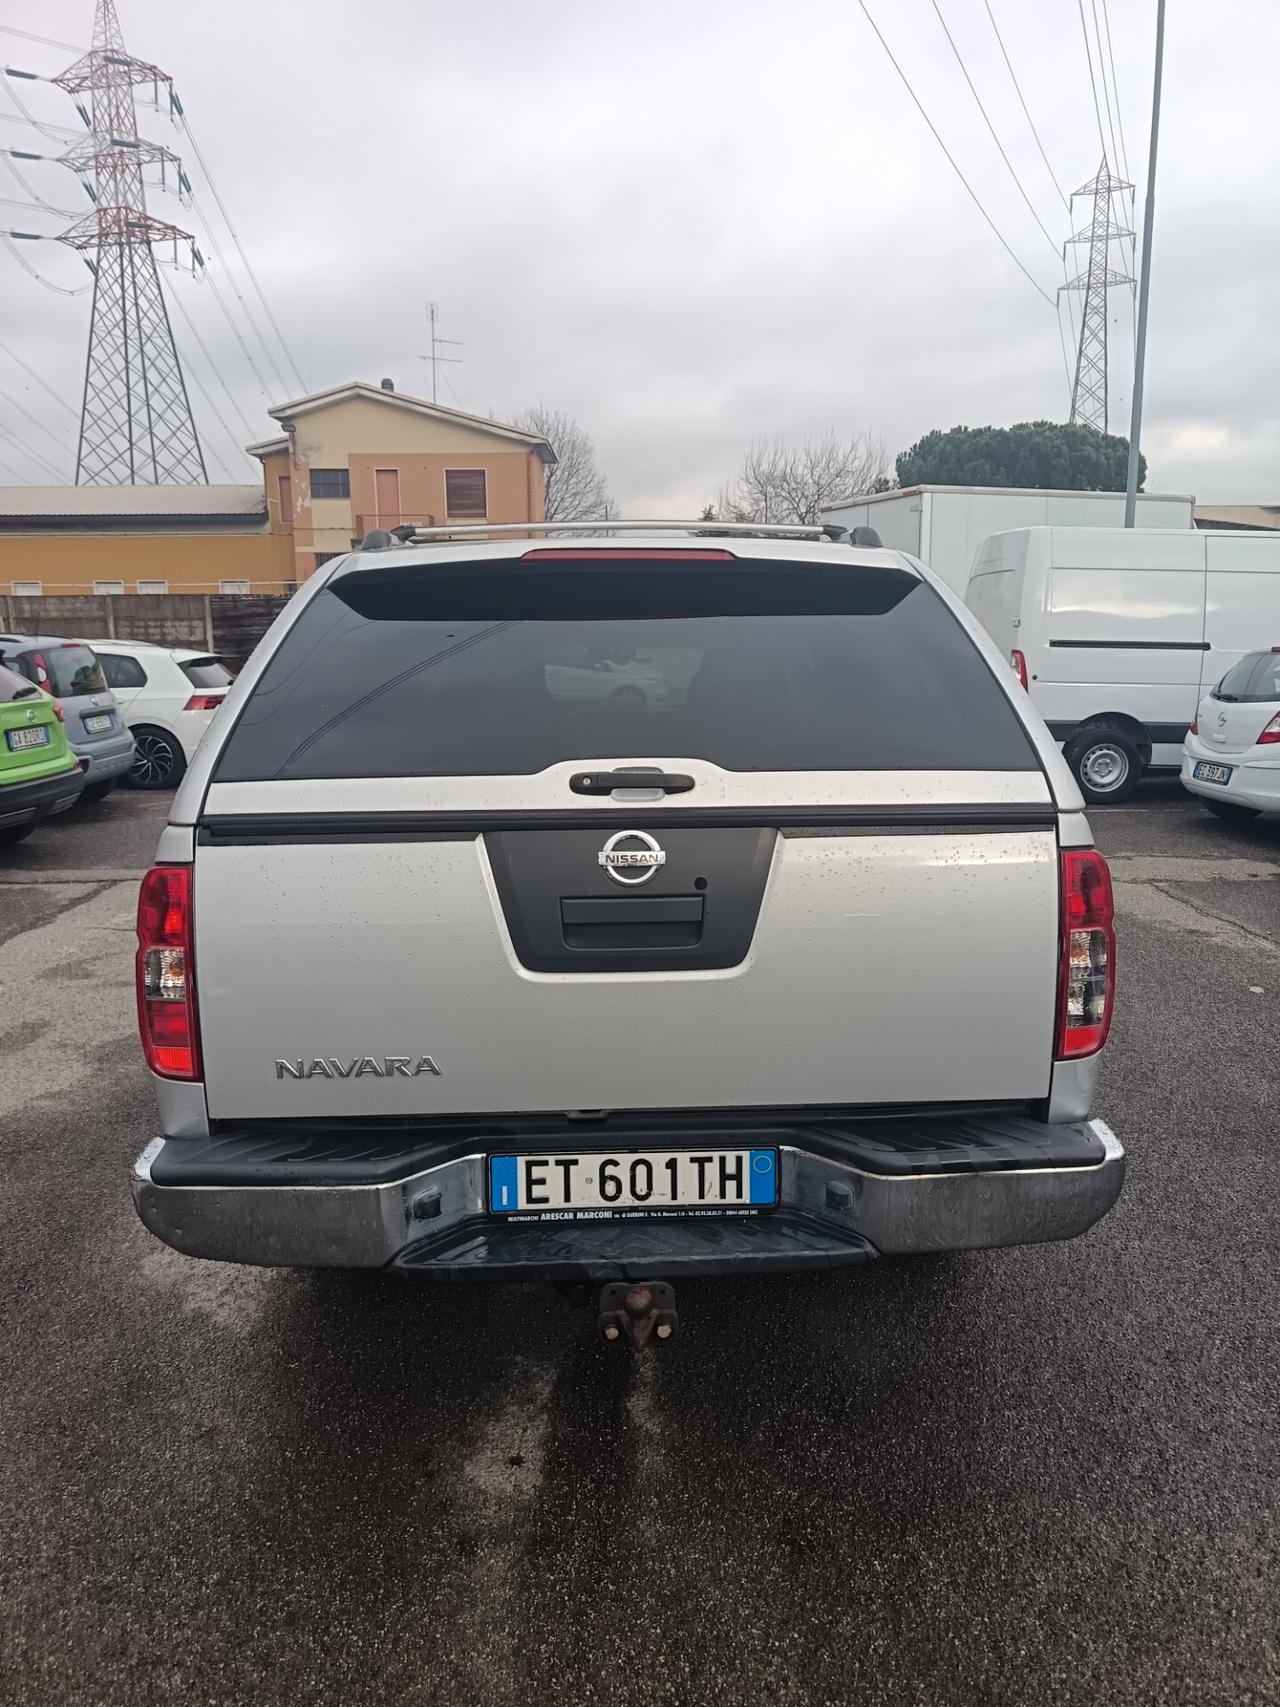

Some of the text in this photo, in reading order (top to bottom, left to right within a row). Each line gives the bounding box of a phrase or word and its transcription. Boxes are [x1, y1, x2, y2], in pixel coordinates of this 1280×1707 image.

[605, 854, 659, 864] NISSAN
[275, 1055, 442, 1080] NAVARA
[525, 1158, 579, 1205] ET
[598, 1155, 744, 1203] 601TH
[540, 1212, 574, 1221] ARESCAR
[576, 1211, 613, 1220] MARCONI
